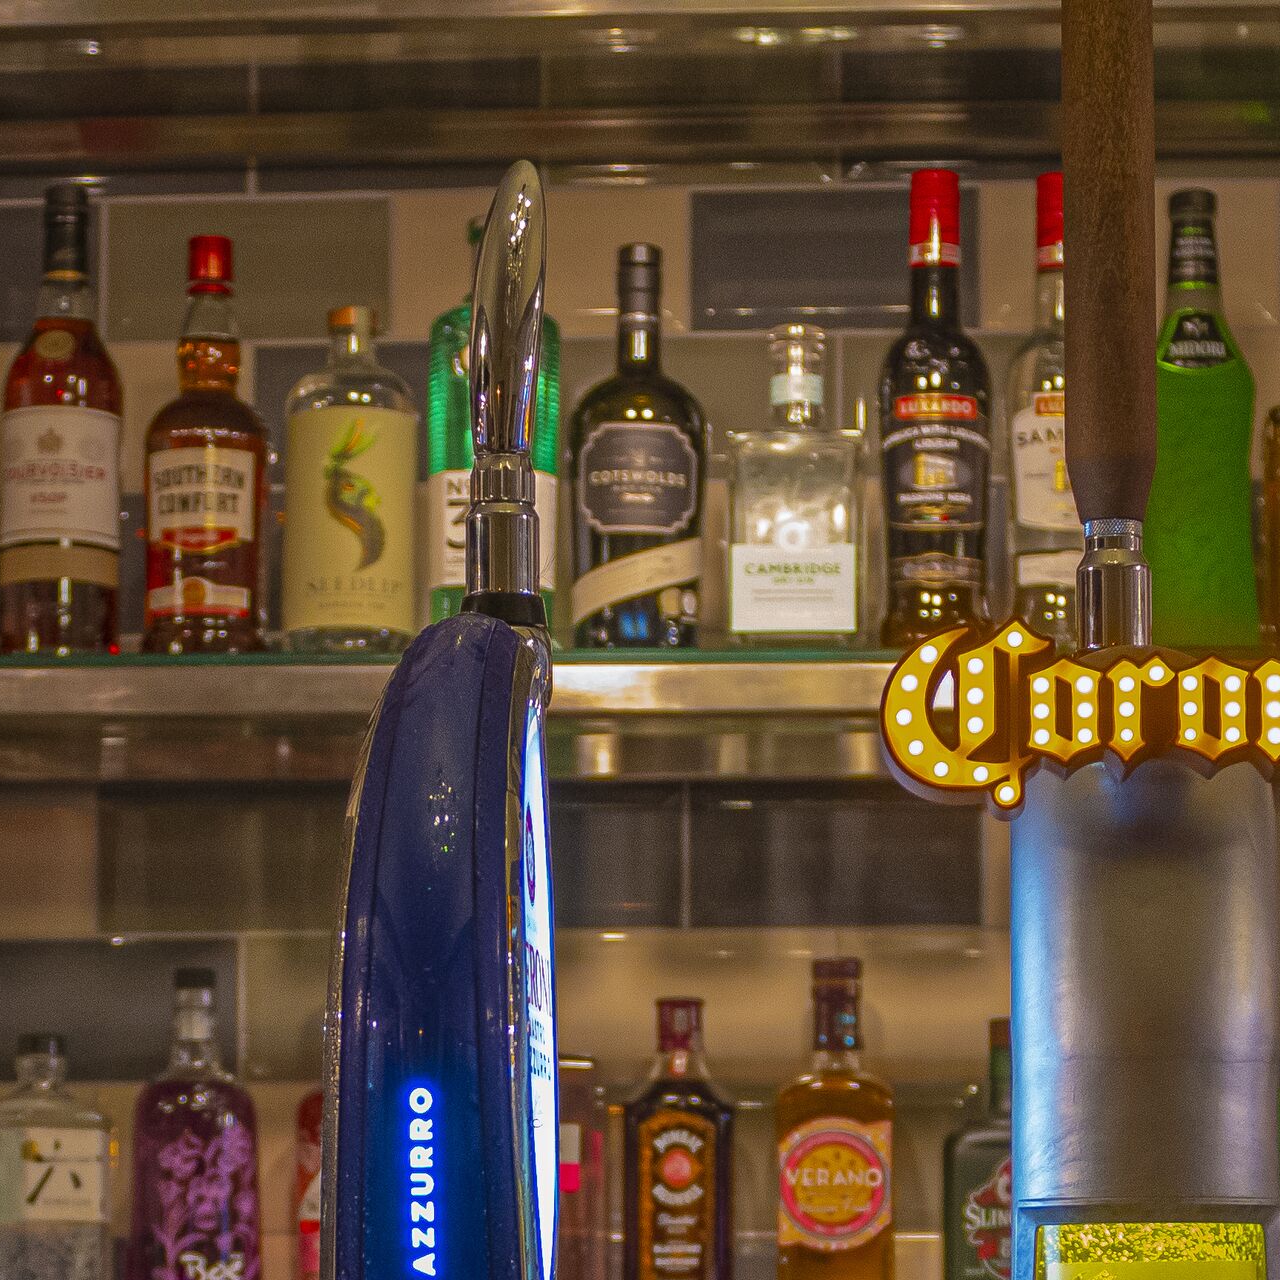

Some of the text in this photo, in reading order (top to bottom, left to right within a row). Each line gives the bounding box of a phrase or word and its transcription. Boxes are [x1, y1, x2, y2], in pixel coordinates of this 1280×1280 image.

[900, 400, 972, 417] LUXARDO
[744, 562, 842, 577] CAMBRIDGE
[409, 1086, 437, 1277] AZZURRO
[784, 1167, 884, 1188] VERANO
